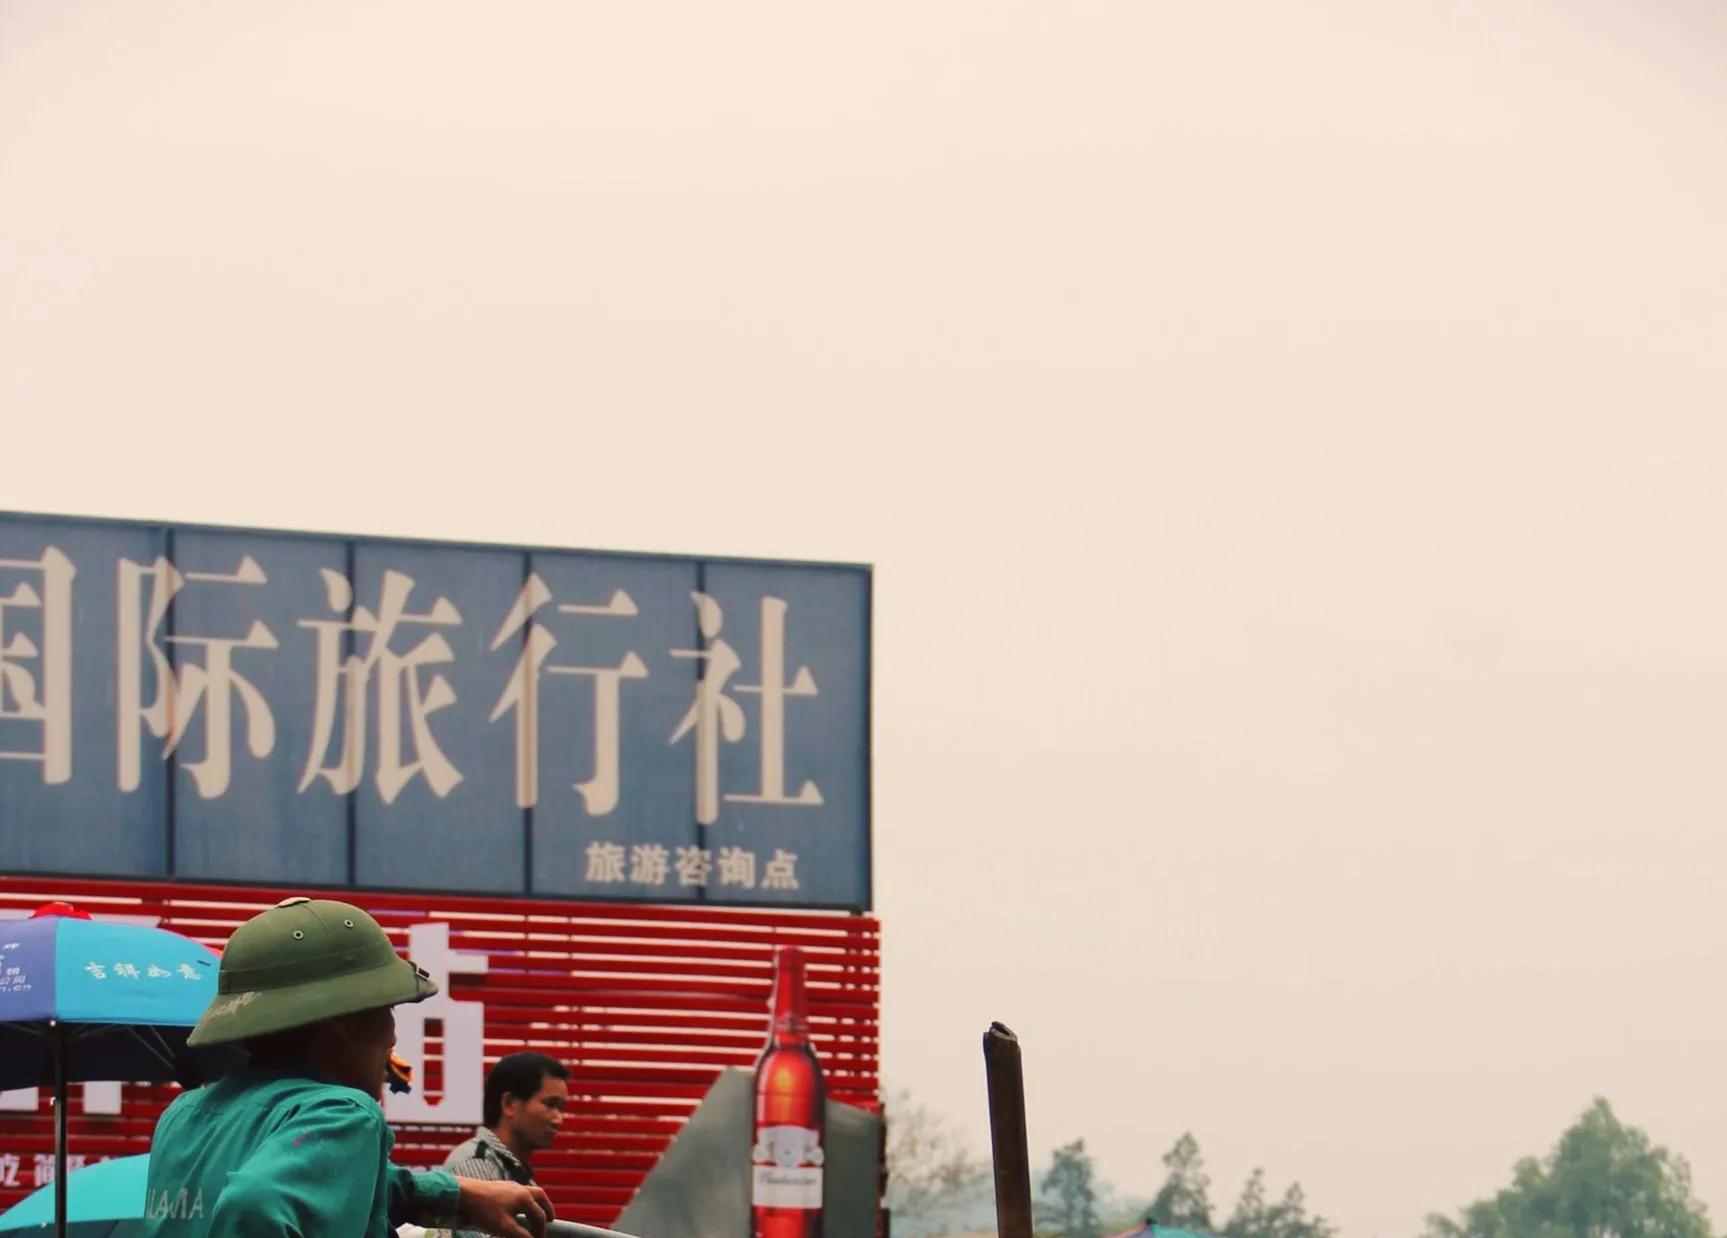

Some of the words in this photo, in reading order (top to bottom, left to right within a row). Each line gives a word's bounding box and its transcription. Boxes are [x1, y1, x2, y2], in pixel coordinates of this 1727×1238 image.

[584, 841, 800, 889] 旅游咨询点
